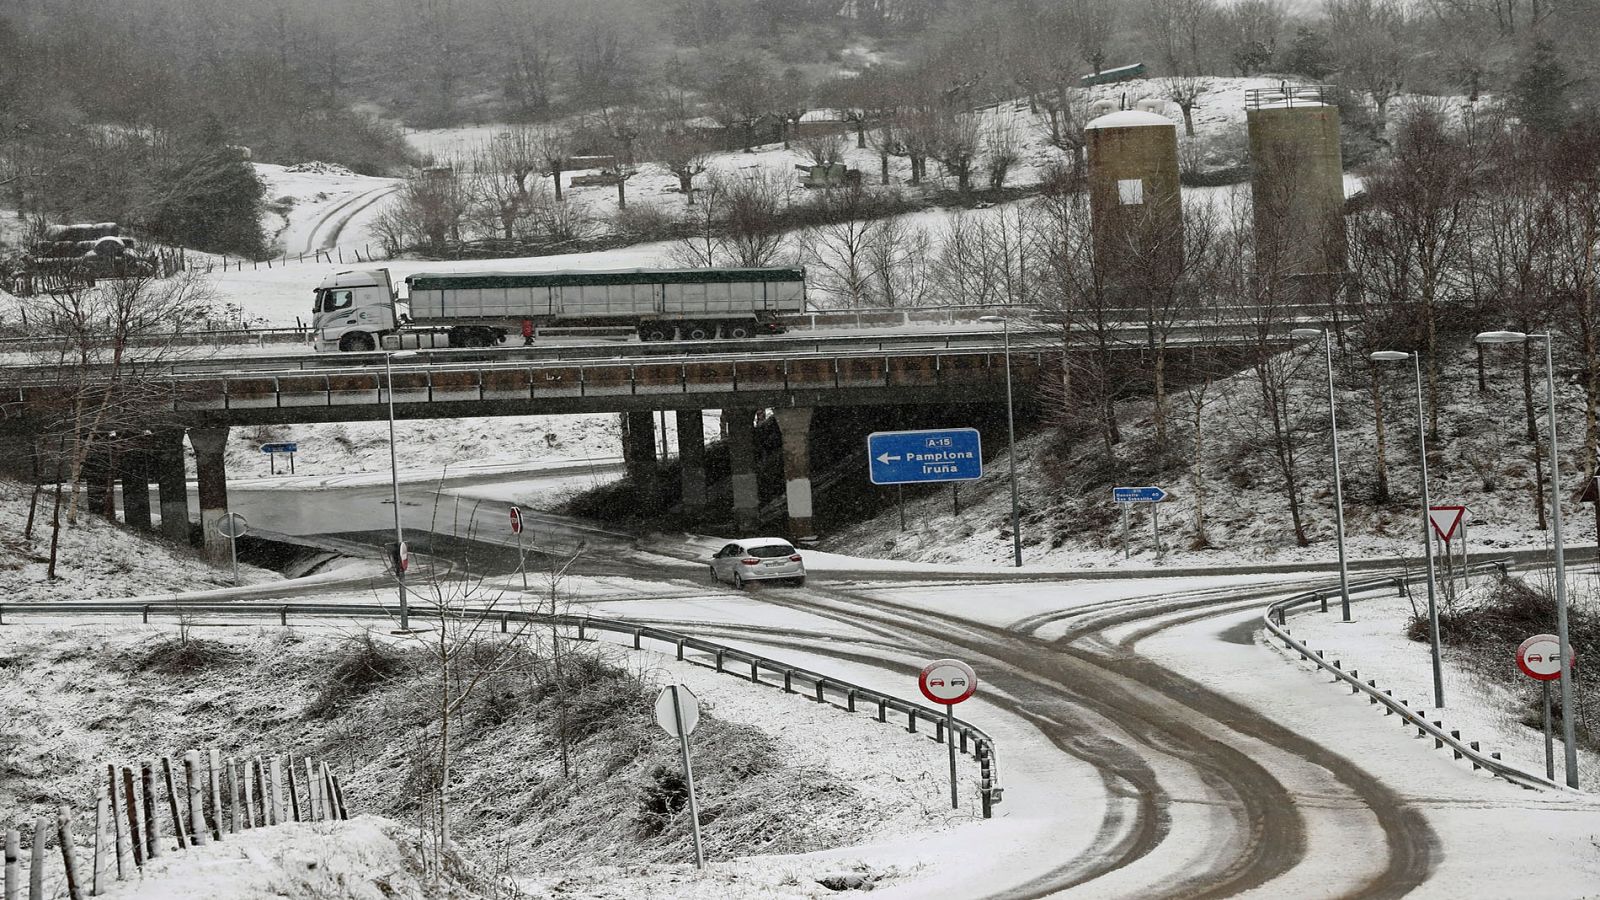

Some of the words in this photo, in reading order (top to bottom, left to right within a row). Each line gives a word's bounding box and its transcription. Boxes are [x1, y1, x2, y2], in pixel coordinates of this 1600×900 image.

[928, 438, 951, 447] A-15
[906, 451, 974, 462] Pamplona
[922, 465, 958, 474] Iruña
